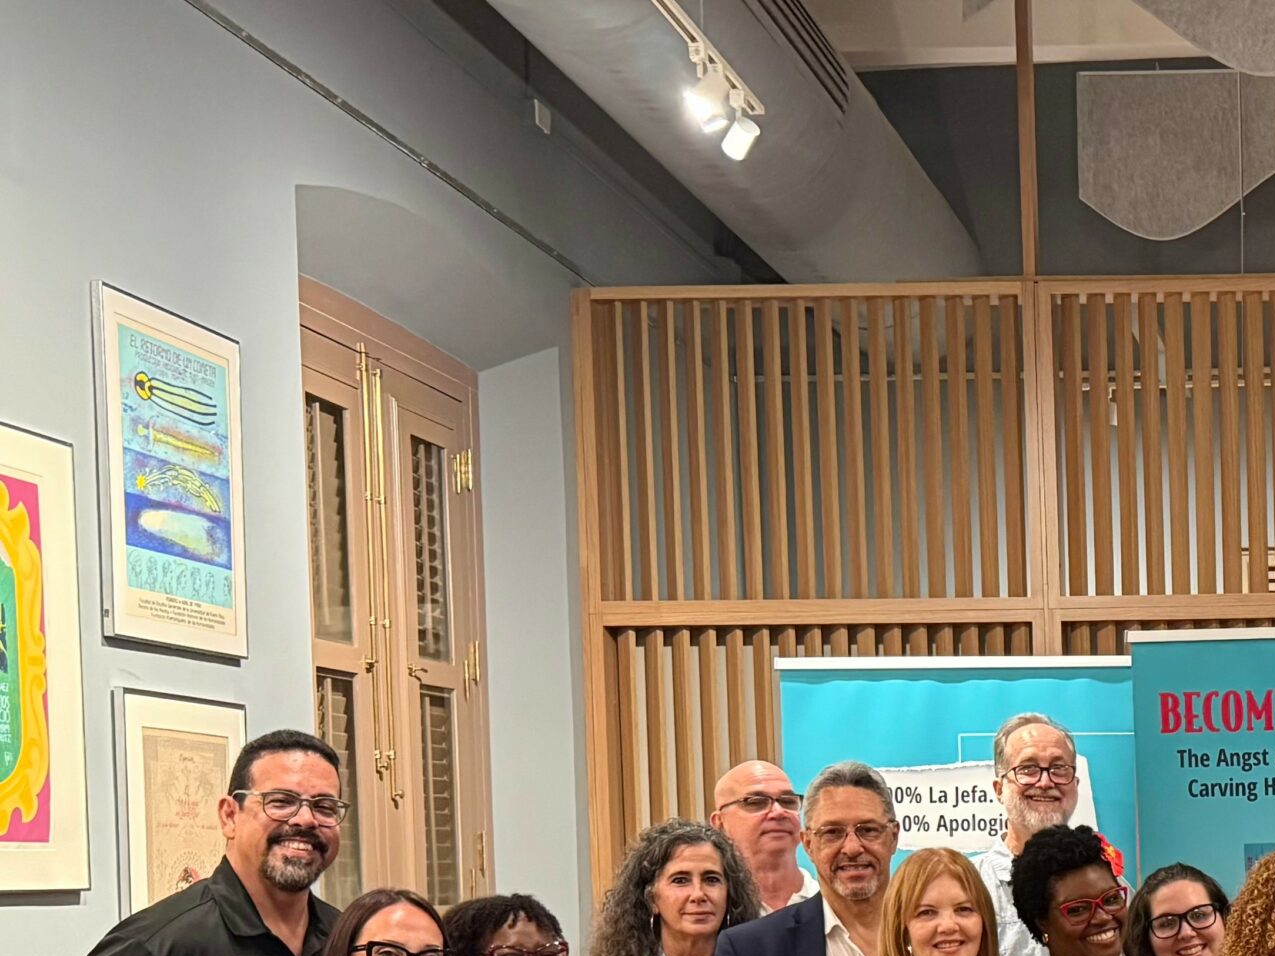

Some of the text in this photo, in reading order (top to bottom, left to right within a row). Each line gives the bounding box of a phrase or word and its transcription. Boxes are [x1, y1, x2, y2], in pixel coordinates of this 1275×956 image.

[1177, 748, 1210, 769] The
[1216, 748, 1269, 772] Angst
[929, 786, 948, 804] La
[952, 785, 994, 808] Jefa.
[1188, 778, 1258, 802] Carving
